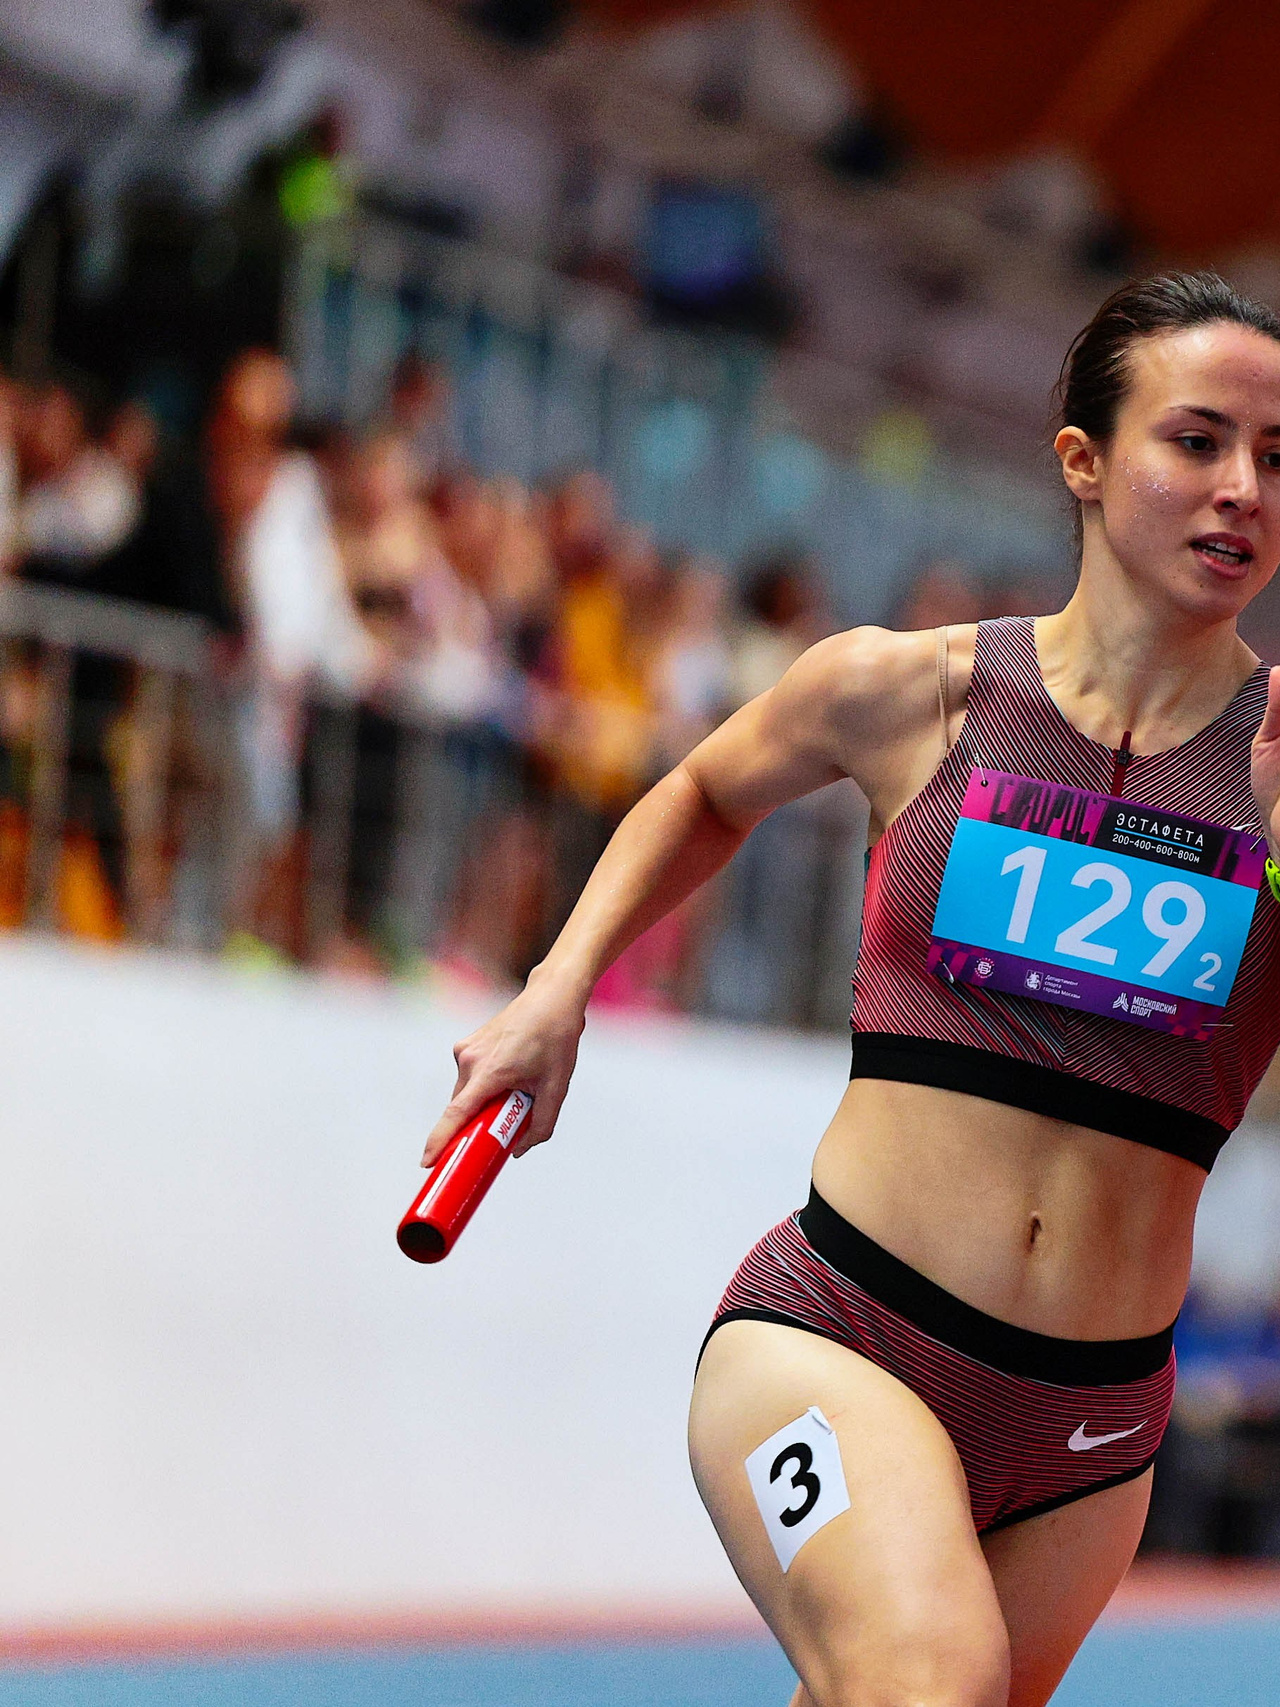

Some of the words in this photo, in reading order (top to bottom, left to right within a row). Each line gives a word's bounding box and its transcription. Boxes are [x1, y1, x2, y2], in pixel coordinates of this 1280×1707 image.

[1115, 812, 1205, 847] ЭСТАФЕТА
[1000, 845, 1206, 978] 129
[1193, 952, 1223, 992] 2
[1130, 1004, 1153, 1019] СПОРТ
[1132, 994, 1178, 1016] МОСКОВСКИЙ
[770, 1442, 821, 1528] 3
